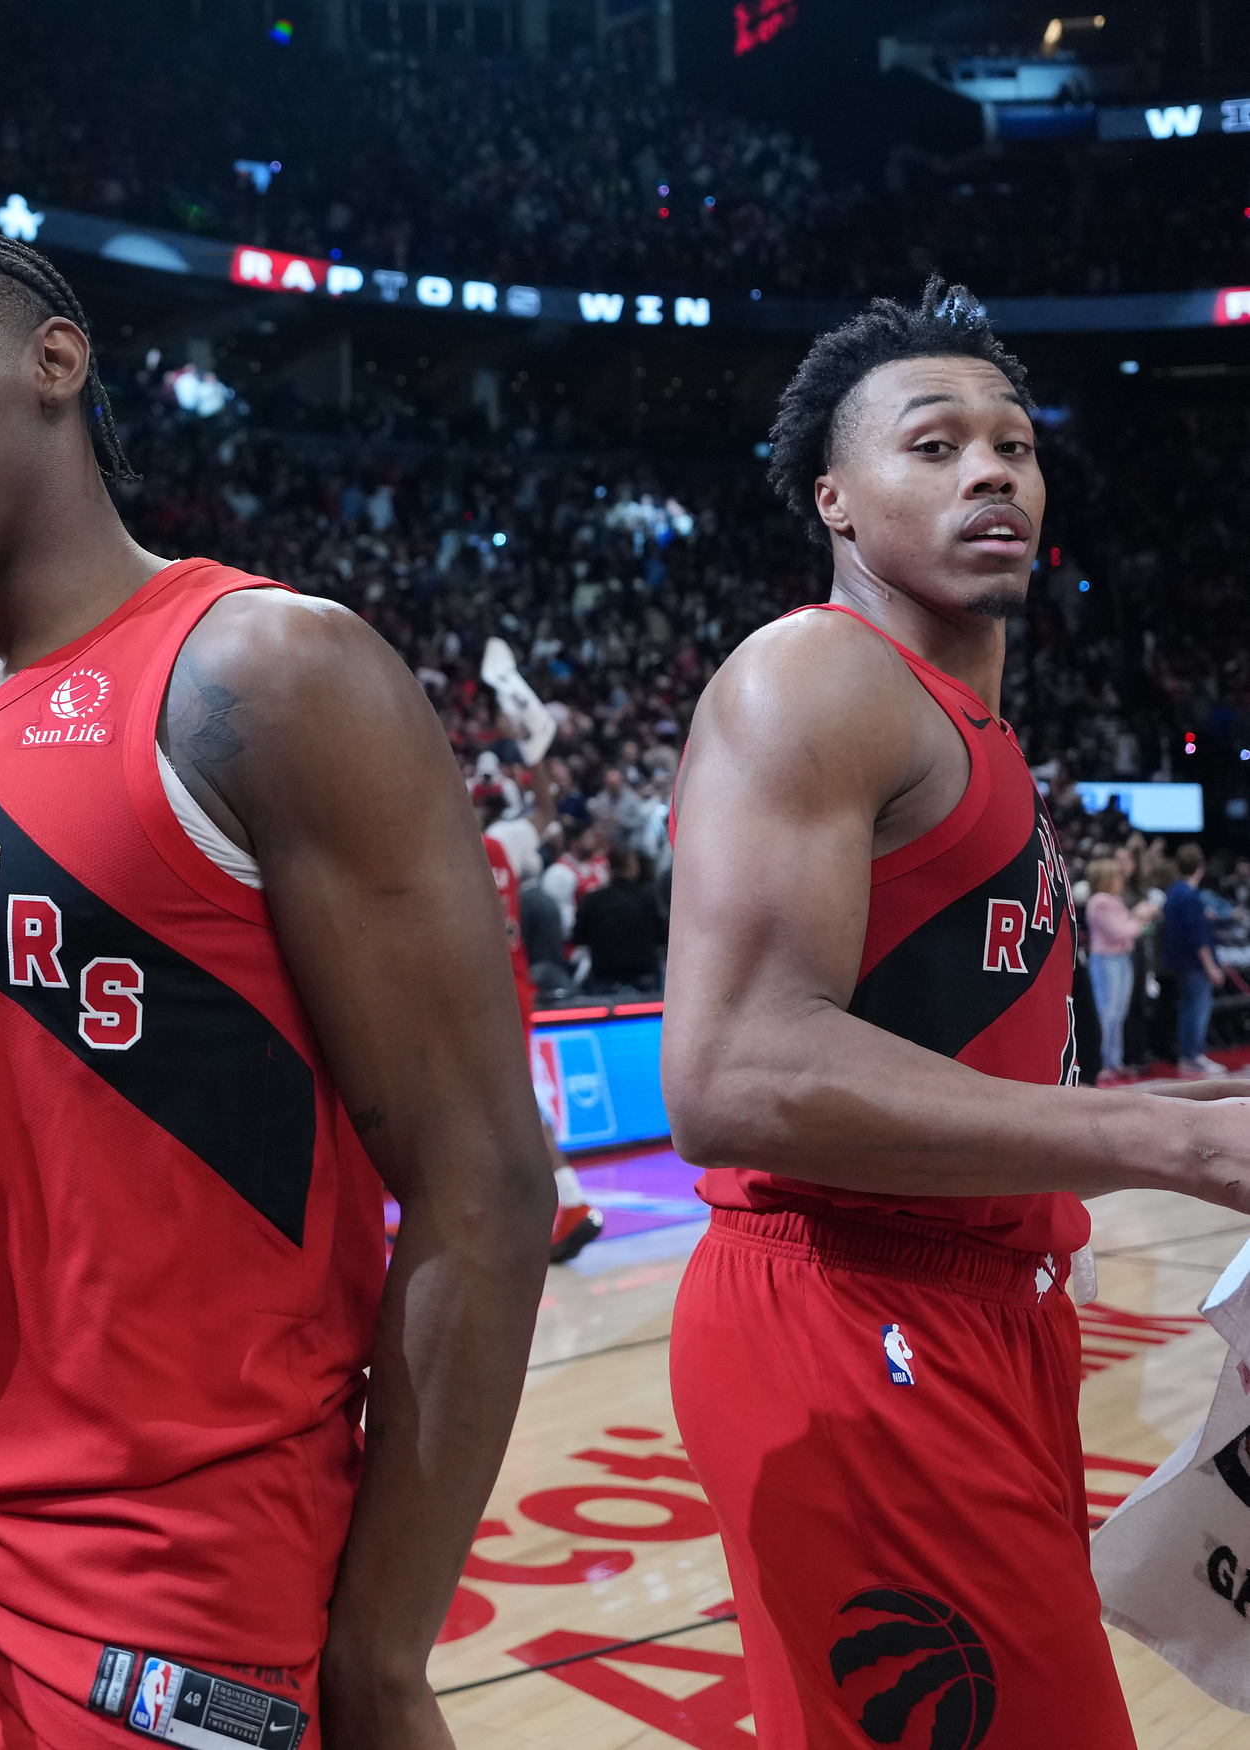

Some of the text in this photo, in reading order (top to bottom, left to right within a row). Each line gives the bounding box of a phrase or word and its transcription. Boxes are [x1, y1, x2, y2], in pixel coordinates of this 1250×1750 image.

[238, 246, 711, 328] RAPTORS WIN
[22, 722, 106, 745] Sun Life
[892, 1372, 908, 1383] NBA
[183, 1690, 202, 1708] 48
[134, 1710, 149, 1726] NBA
